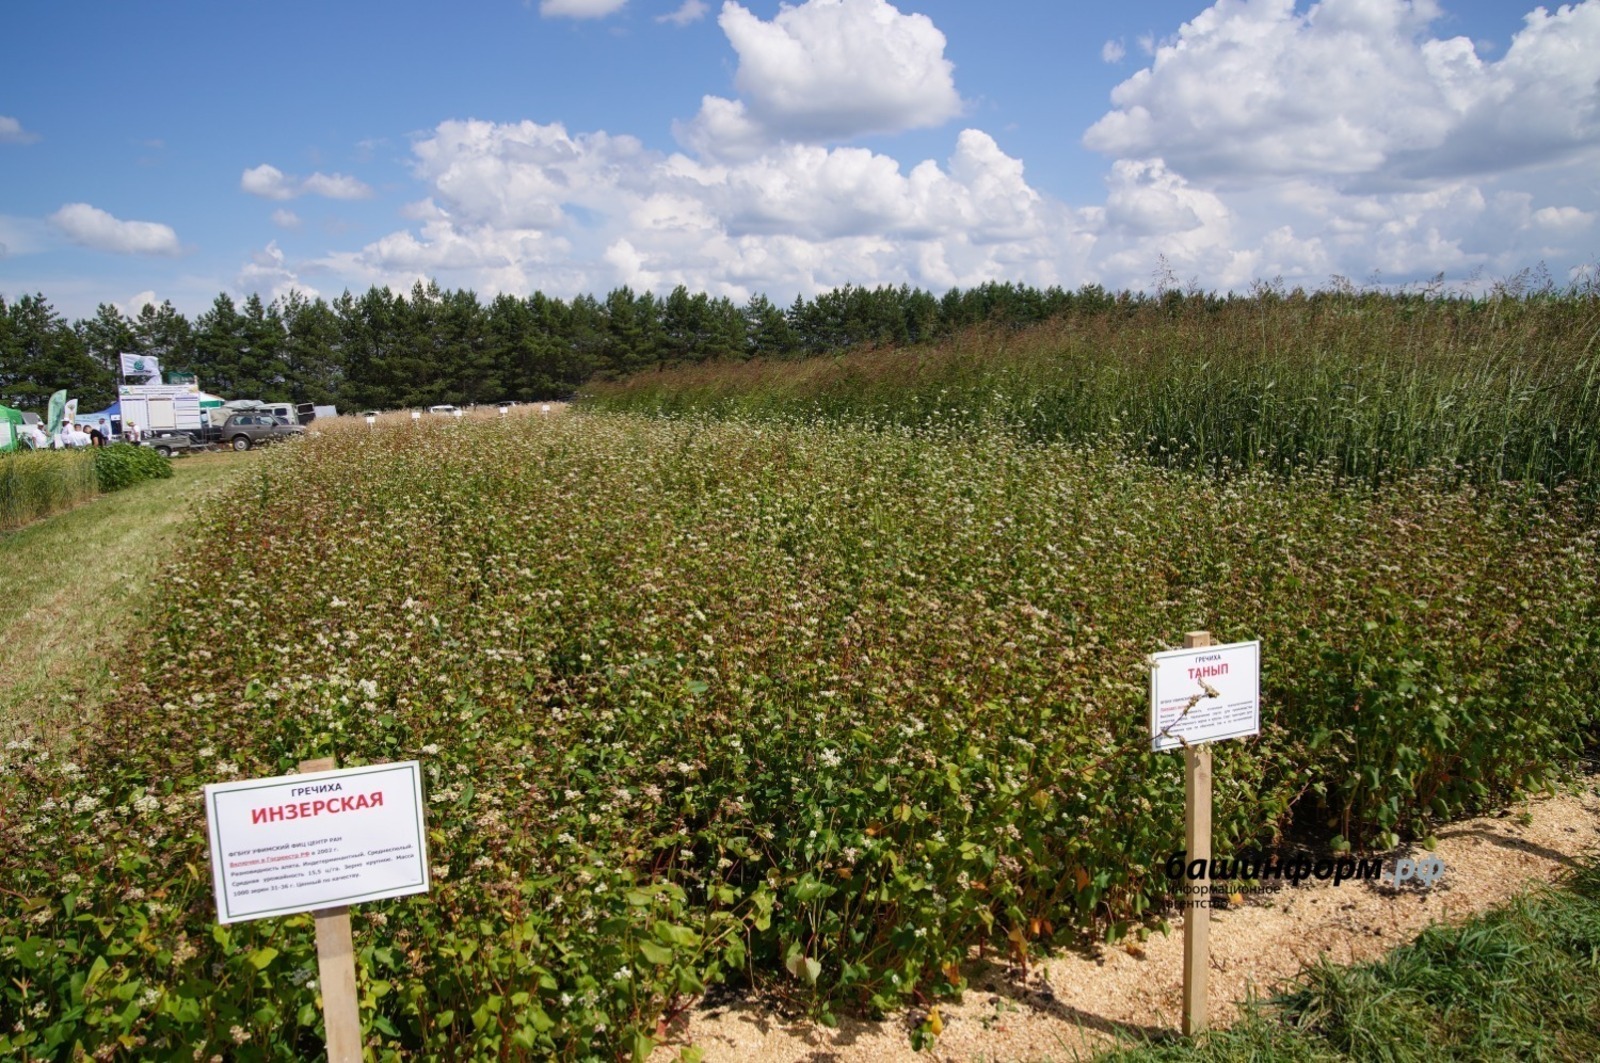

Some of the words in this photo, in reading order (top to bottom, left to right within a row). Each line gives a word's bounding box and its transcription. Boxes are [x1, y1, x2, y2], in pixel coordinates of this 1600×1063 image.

[1195, 653, 1222, 663] ГРЕЧИХА
[1188, 663, 1229, 680] ТАНЫП
[291, 782, 343, 797] ГРЕЧИХА
[251, 791, 384, 825] ИНЗЕРСКАЯ
[252, 843, 290, 854] УФИМСКИЙ
[307, 838, 328, 846] ЦЕНТР
